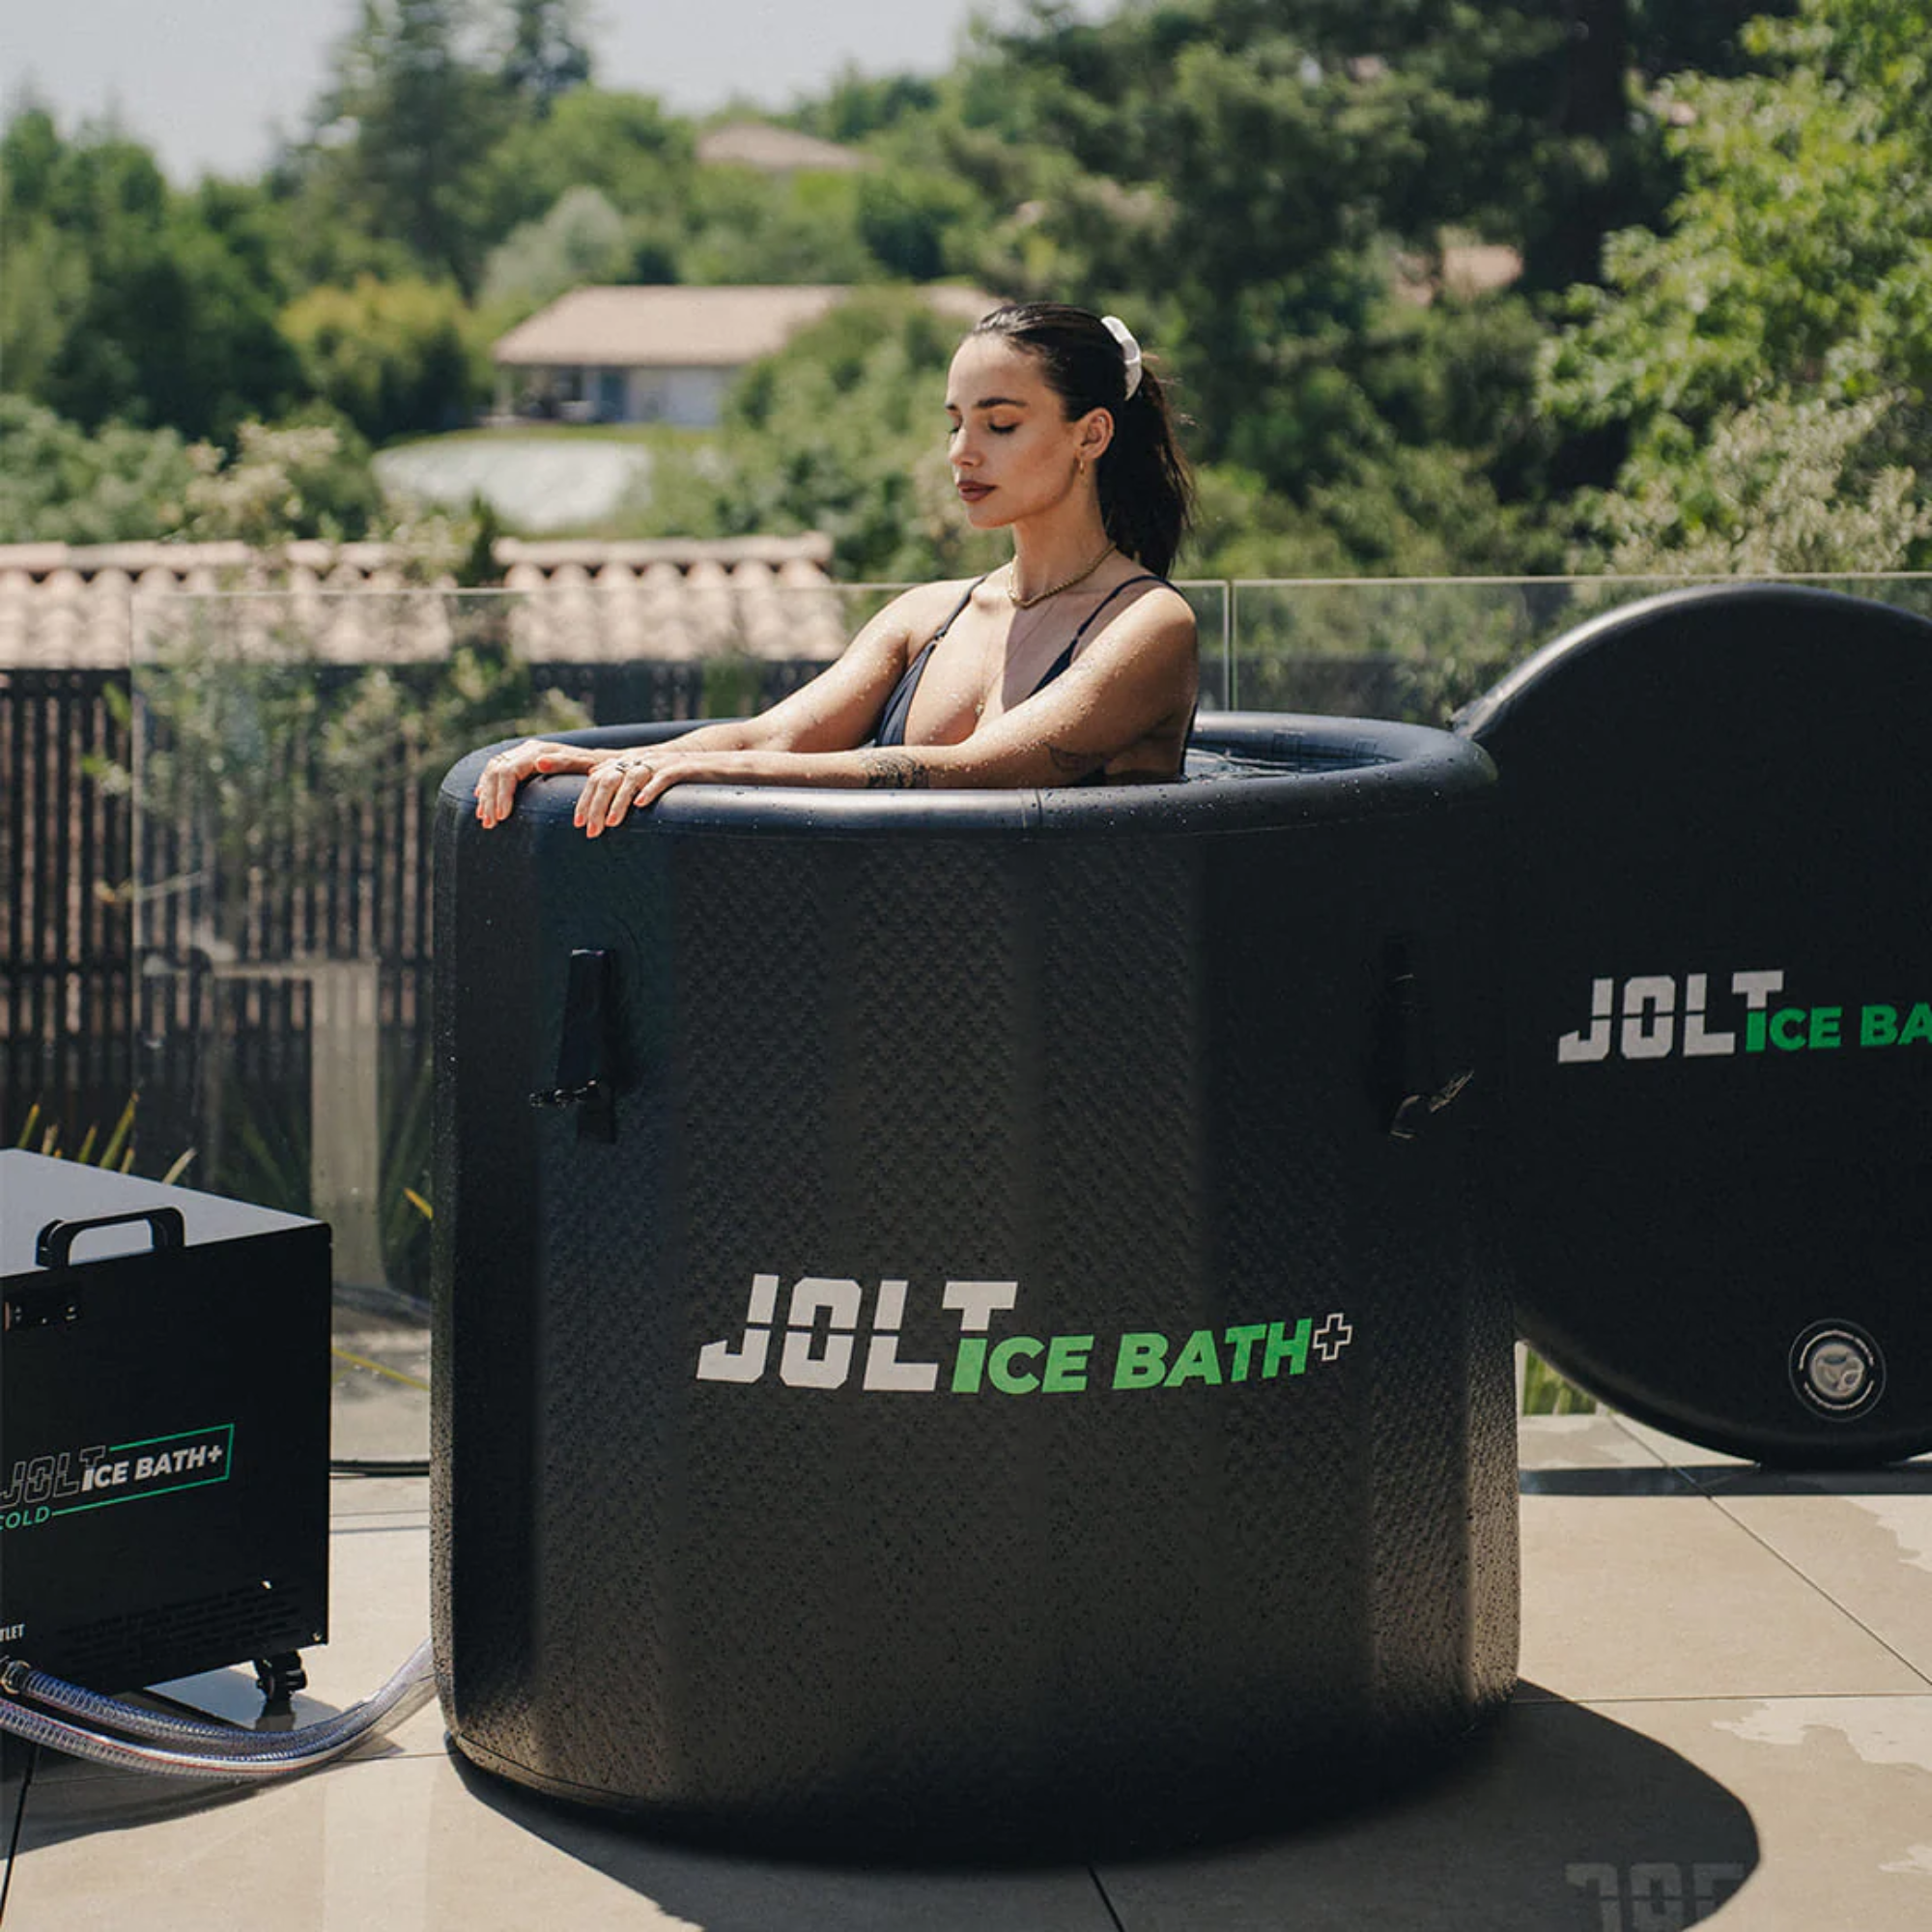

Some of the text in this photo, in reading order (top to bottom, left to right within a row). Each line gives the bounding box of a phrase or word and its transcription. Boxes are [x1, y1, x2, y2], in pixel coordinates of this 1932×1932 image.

[1558, 970, 1784, 1063] JOLT
[1746, 1006, 1842, 1053] ICE
[696, 1273, 1018, 1392] JOLT
[951, 1333, 1094, 1394] ICE
[81, 1462, 128, 1492] ICE
